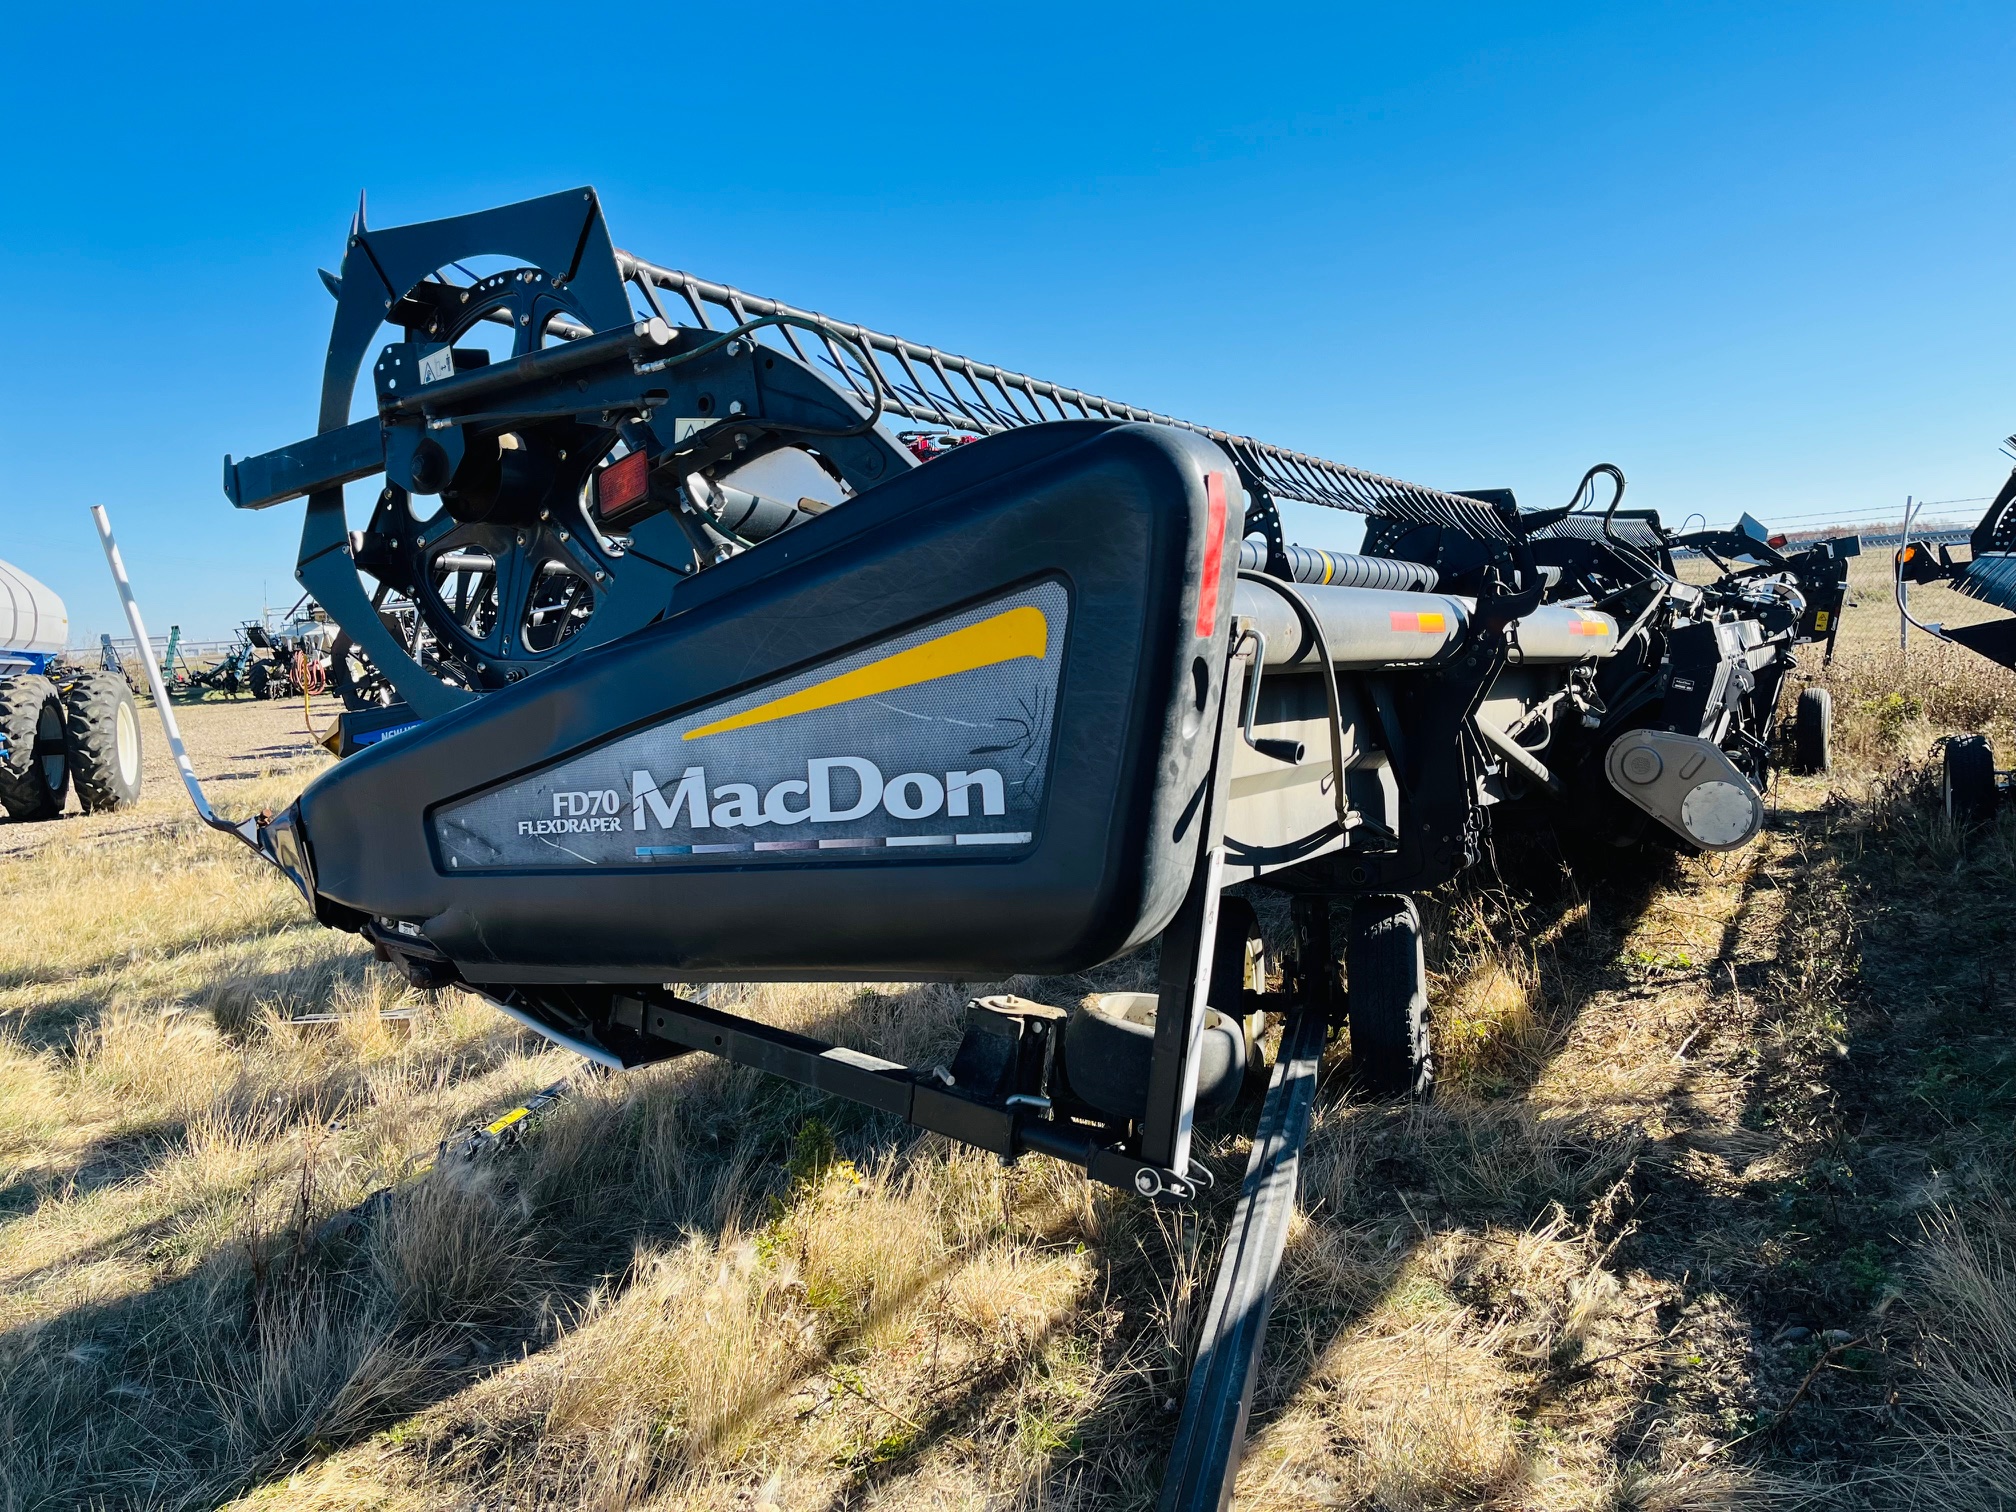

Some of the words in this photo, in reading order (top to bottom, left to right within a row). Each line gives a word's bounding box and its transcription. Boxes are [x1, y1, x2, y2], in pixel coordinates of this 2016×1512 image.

[553, 789, 620, 817] FD70
[632, 756, 1005, 831] MacDon
[518, 817, 623, 835] FLEXDRAPER
